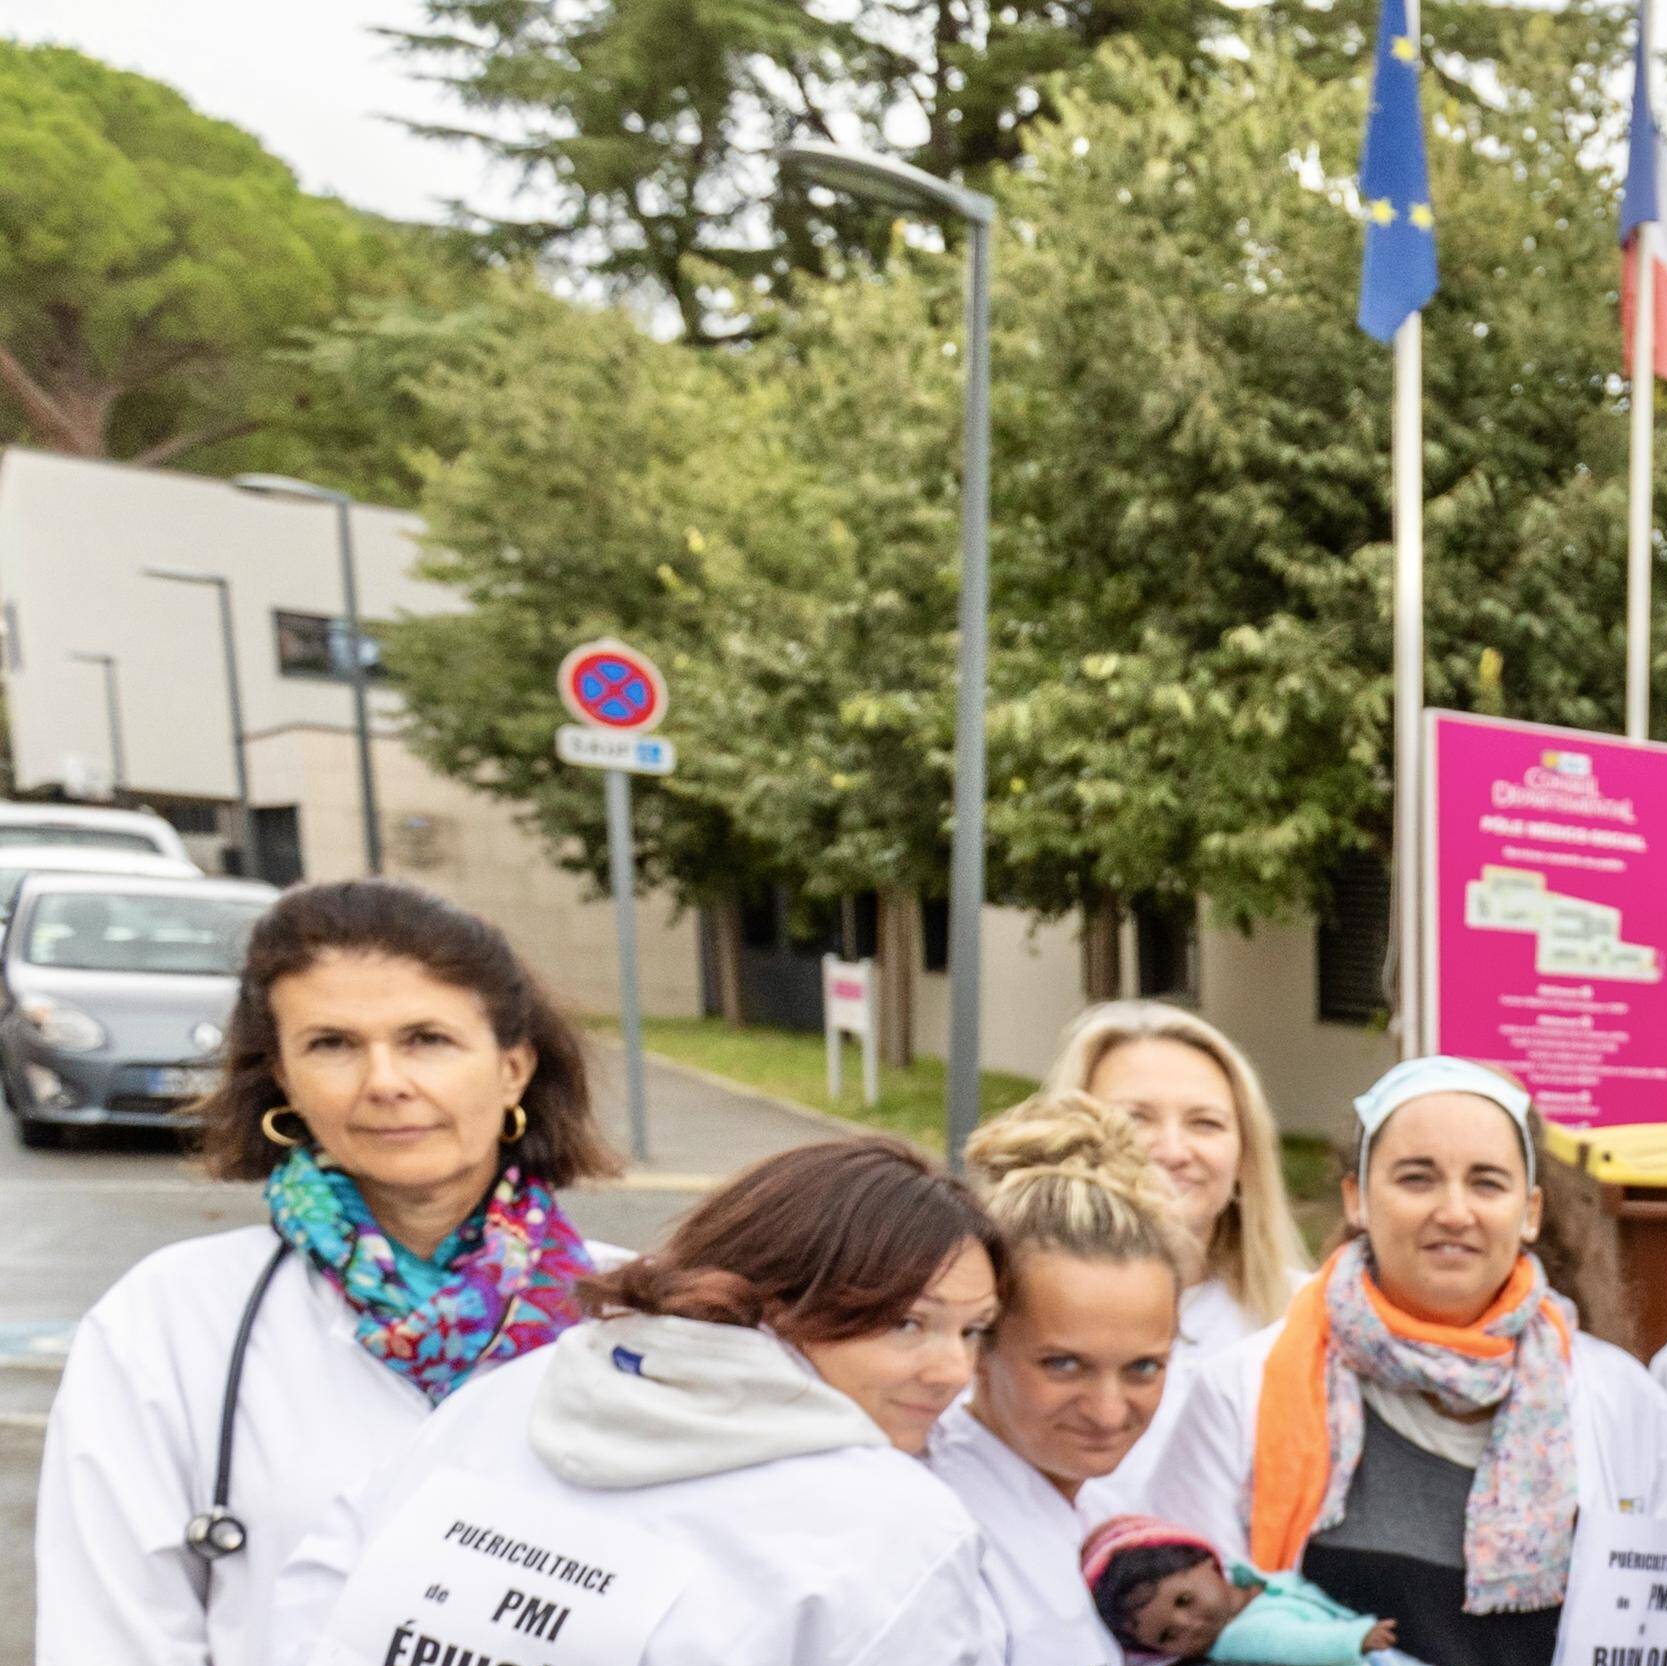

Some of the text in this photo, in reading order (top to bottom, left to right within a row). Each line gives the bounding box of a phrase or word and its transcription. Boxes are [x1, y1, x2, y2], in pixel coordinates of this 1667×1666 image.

[444, 1518, 617, 1596] PUÉRICULTRICE
[424, 1582, 572, 1643] de PMI
